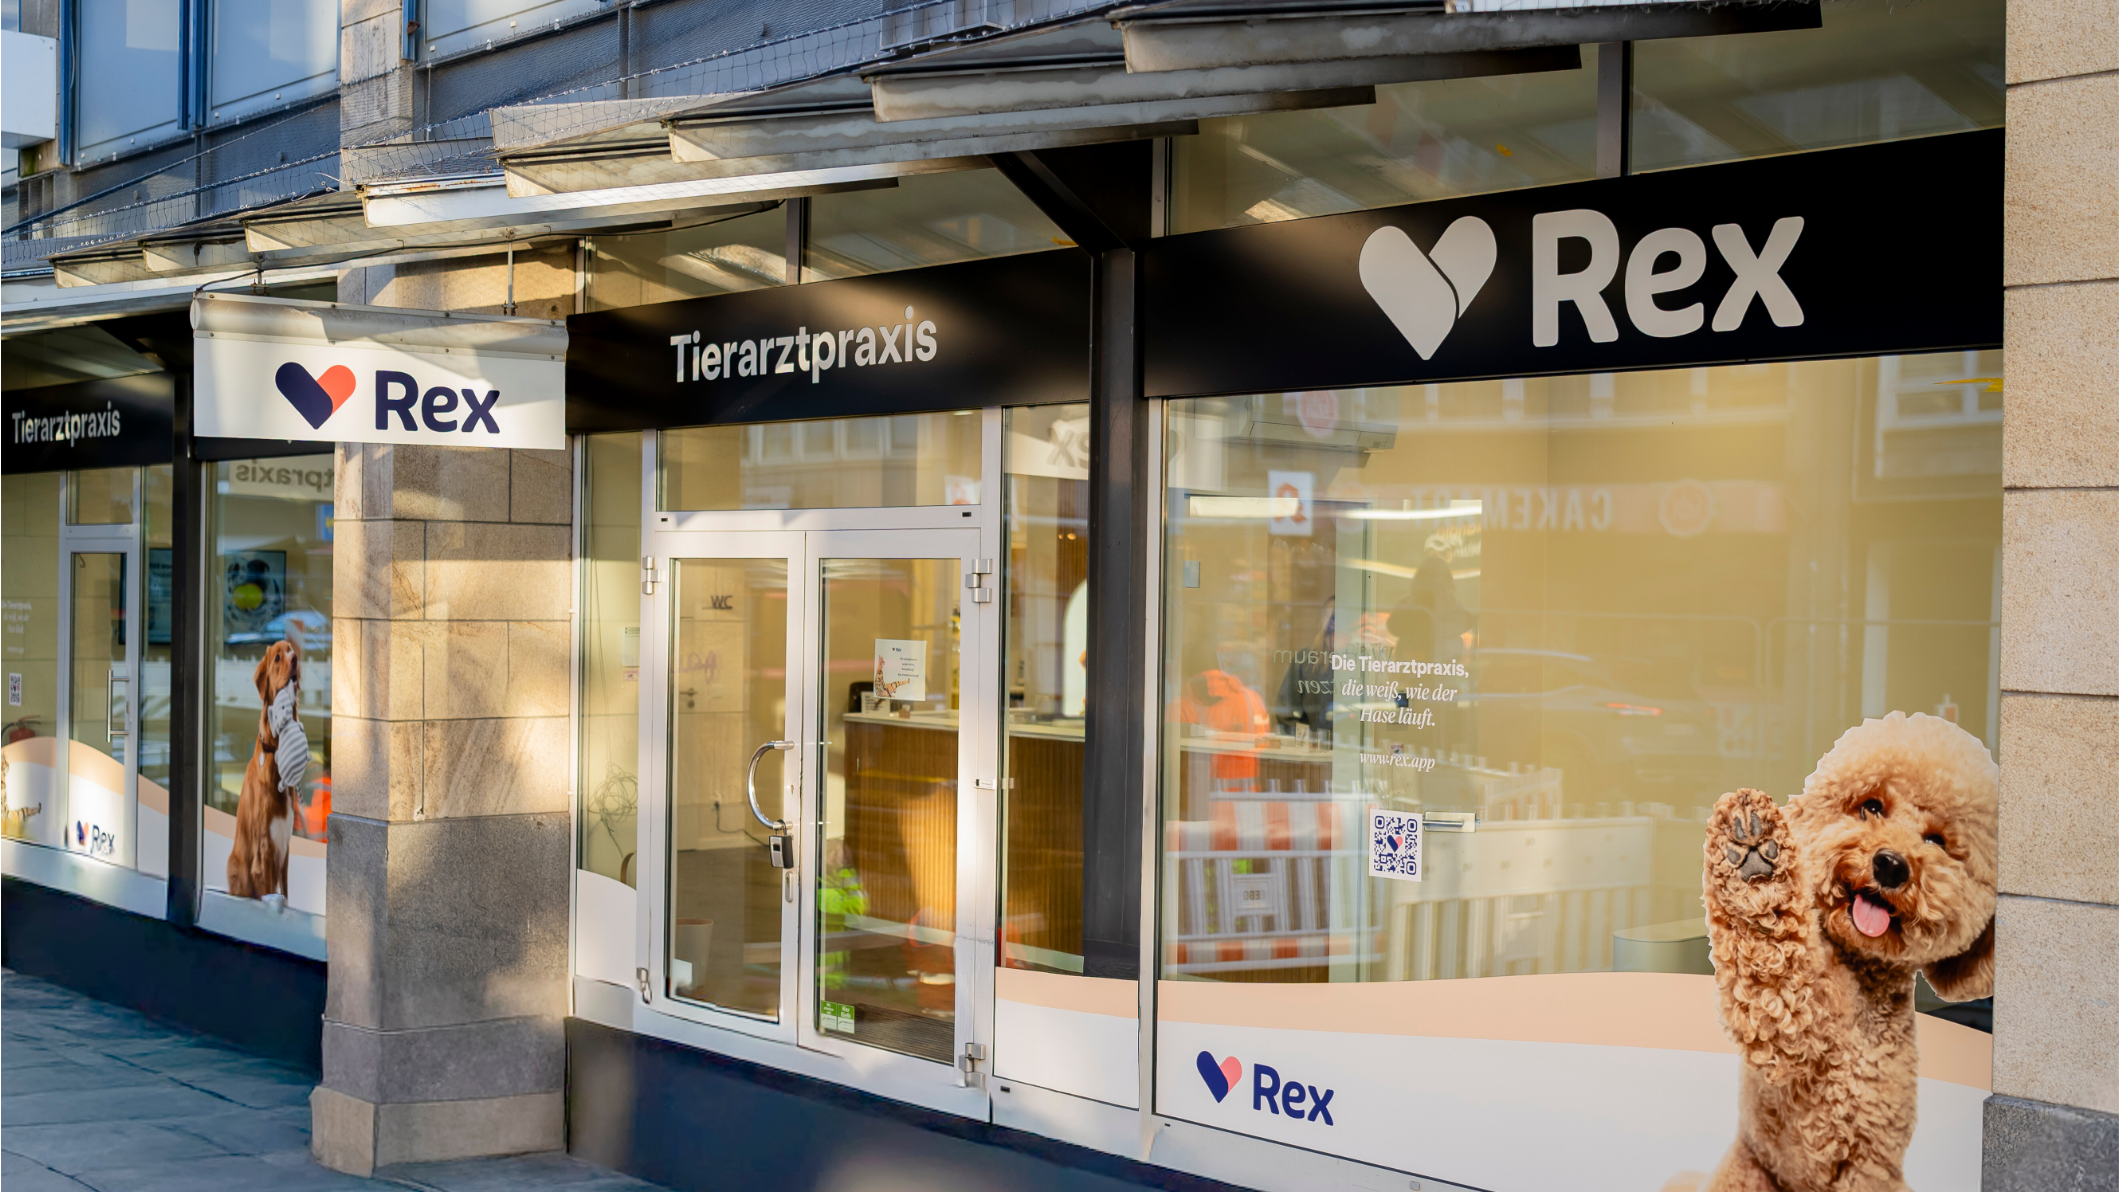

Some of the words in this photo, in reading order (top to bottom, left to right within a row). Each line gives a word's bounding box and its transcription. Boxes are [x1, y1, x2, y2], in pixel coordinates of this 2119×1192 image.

[1532, 208, 1805, 347] Rex
[670, 305, 938, 384] Tierarztpraxis
[11, 399, 121, 448] Tierarztpraxis
[374, 370, 501, 434] Rex
[1332, 654, 1356, 671] Die
[1358, 655, 1469, 679] Tierarztpraxis,
[1341, 679, 1364, 697] die
[1366, 680, 1402, 703] weiß,
[1405, 683, 1429, 701] wie
[1431, 683, 1458, 702] der
[1359, 707, 1396, 724] Hase
[1398, 706, 1436, 730] läuft.
[1359, 752, 1436, 772] www.rex.app
[1252, 1063, 1335, 1127] Rex
